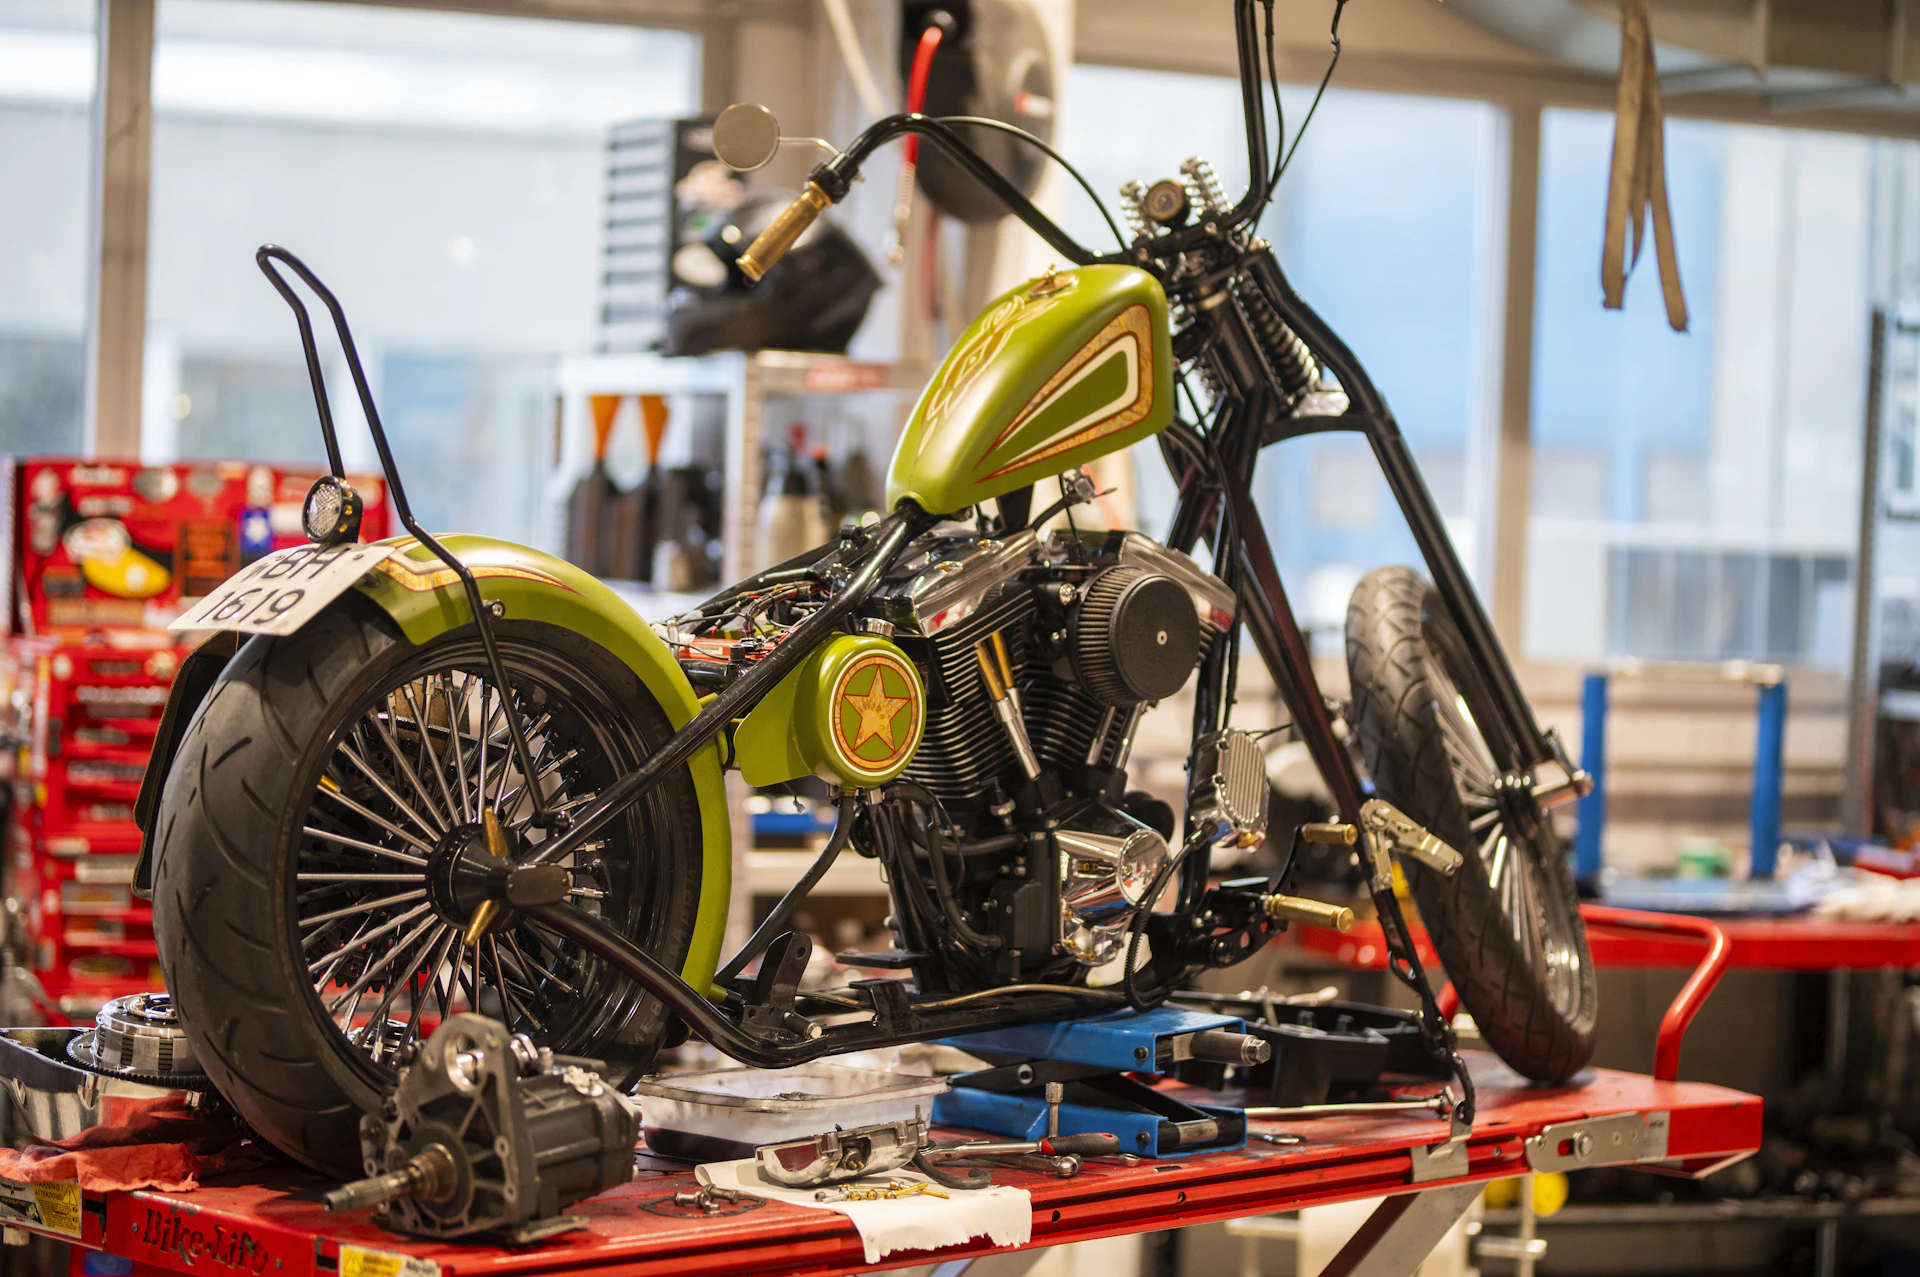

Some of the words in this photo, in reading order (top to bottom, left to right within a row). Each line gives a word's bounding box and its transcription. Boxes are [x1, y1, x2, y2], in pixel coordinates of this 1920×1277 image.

[261, 546, 352, 580] BH
[196, 587, 306, 625] 1619
[142, 1208, 269, 1276] Bike-Lift
